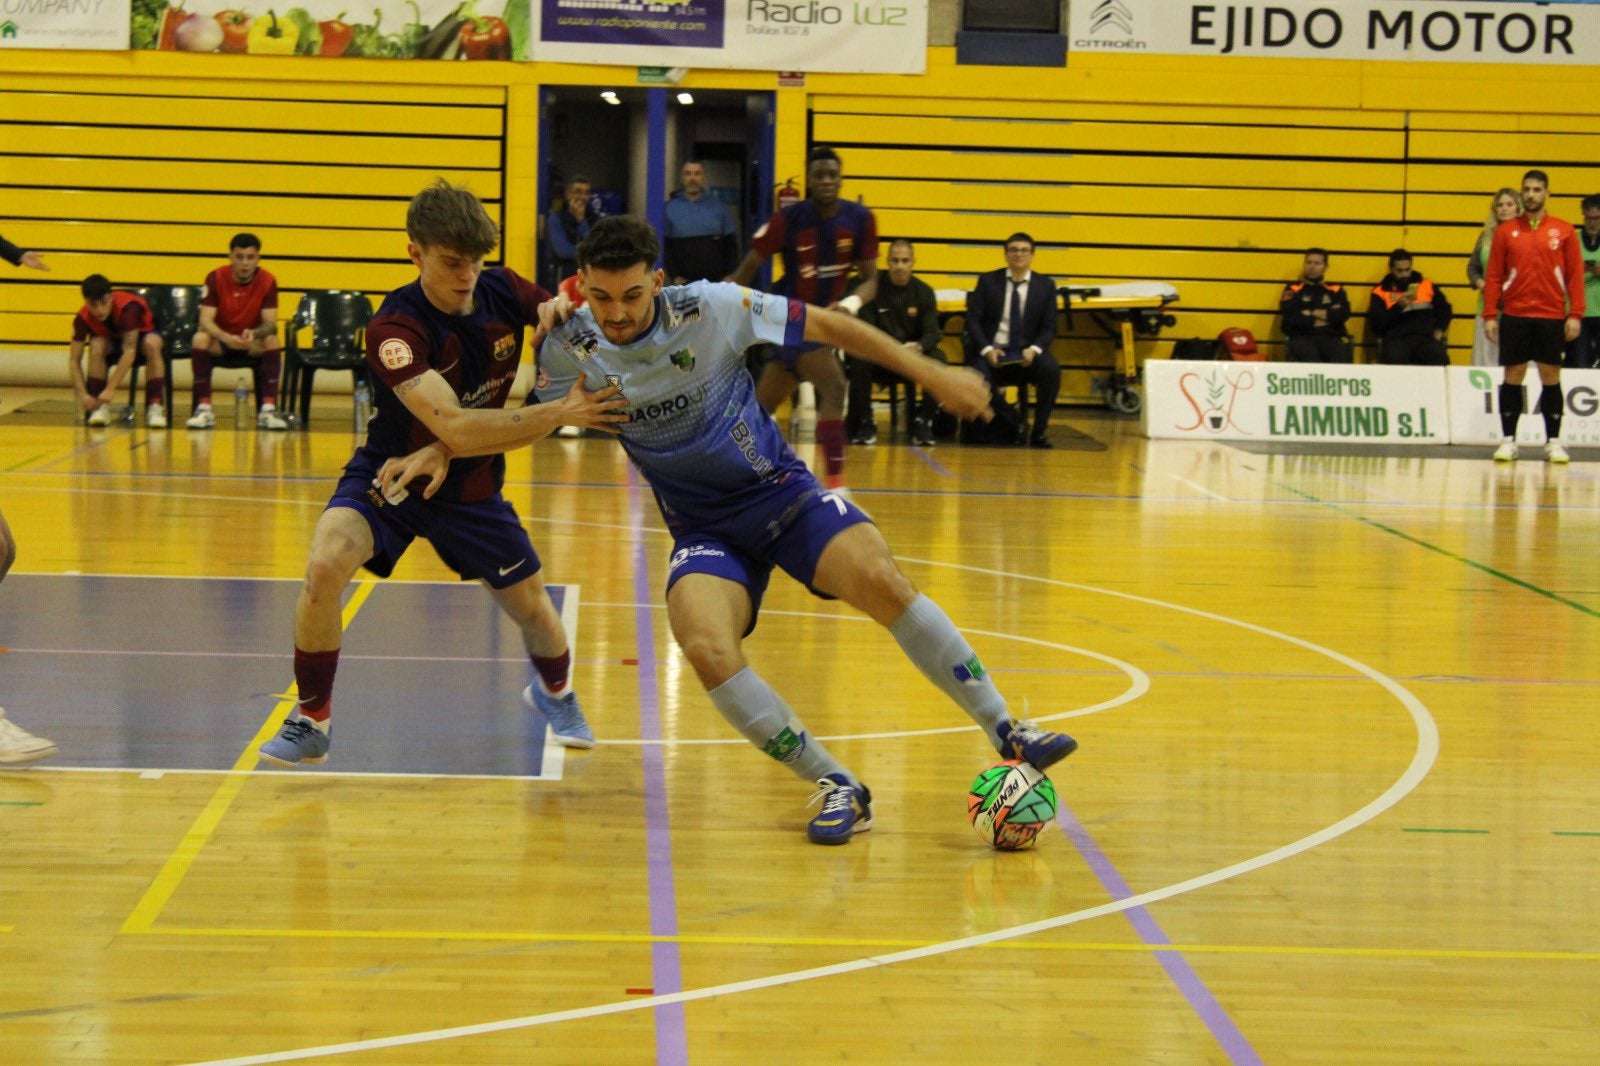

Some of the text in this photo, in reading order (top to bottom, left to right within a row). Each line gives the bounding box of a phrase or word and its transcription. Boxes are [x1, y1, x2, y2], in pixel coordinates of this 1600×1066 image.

[747, 0, 908, 26] Radio luz
[1190, 5, 1575, 54] EJIDO MOTOR
[1266, 372, 1372, 397] Semilleros
[1268, 405, 1436, 438] LAIMUND s.l.
[821, 494, 848, 517] 7
